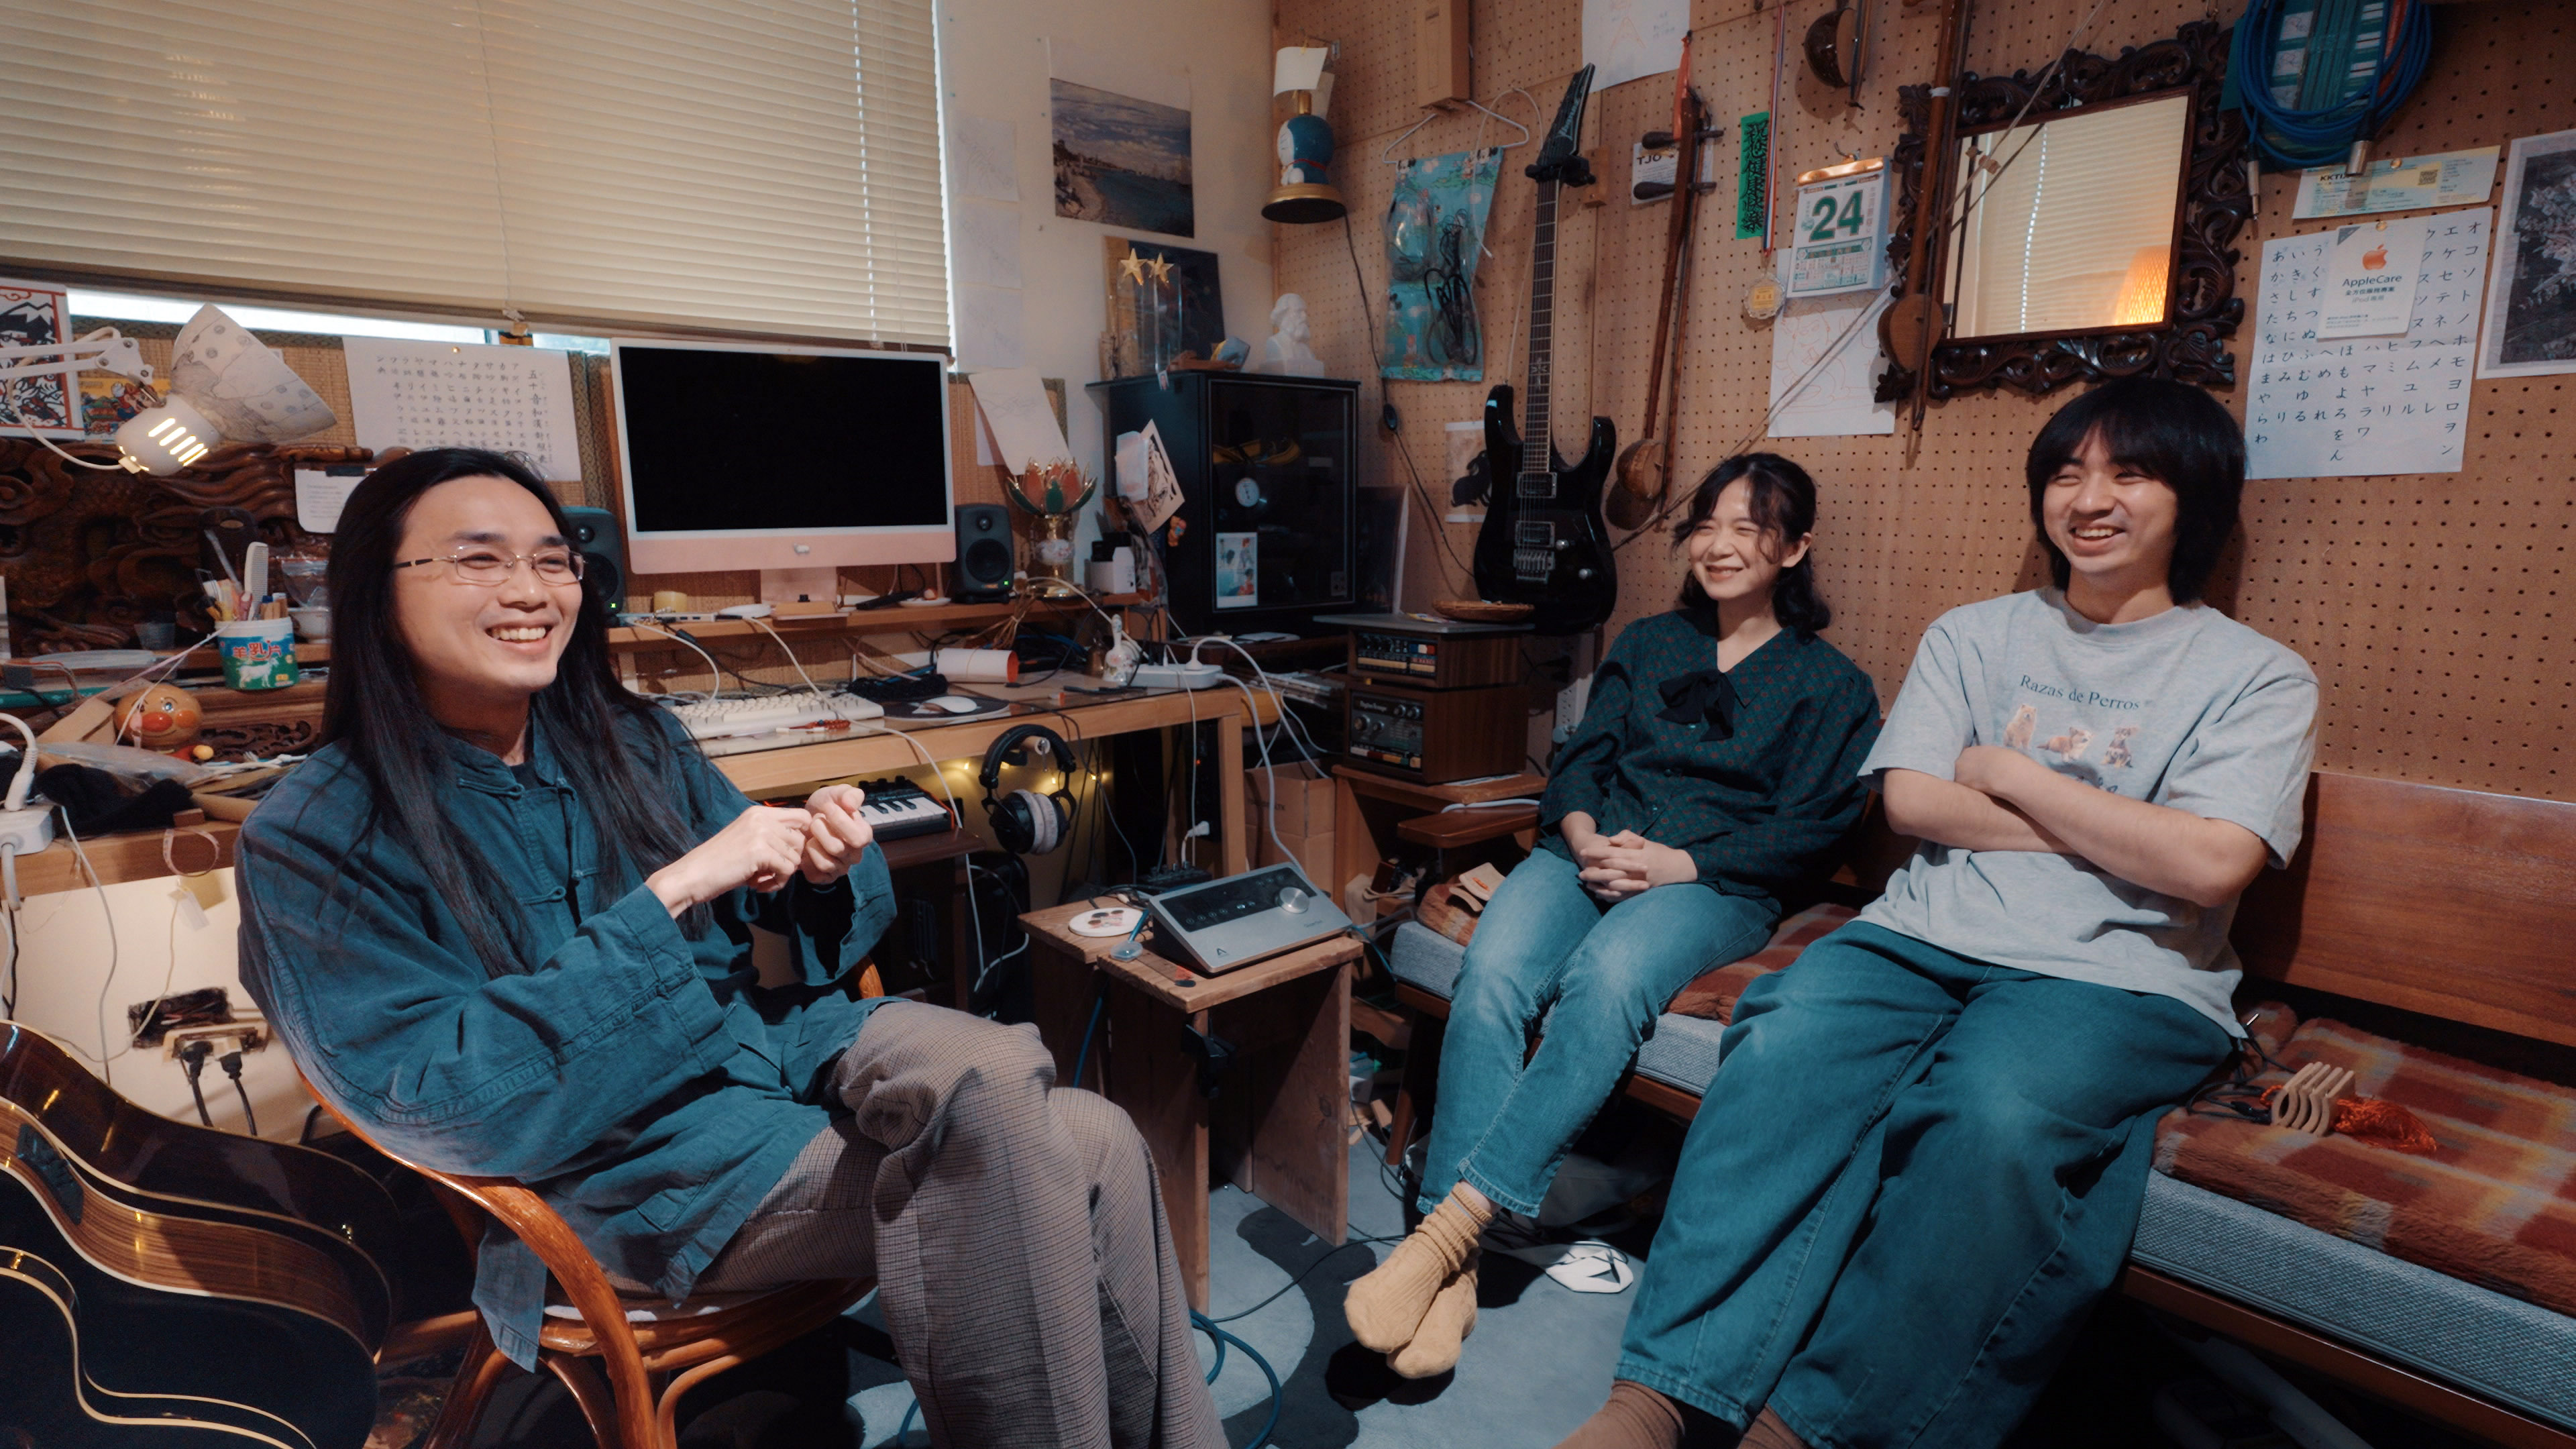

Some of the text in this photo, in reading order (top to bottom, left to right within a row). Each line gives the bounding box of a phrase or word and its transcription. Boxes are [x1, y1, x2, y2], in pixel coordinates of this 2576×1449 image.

[1809, 189, 1864, 242] 24
[2342, 274, 2402, 288] AppleCare
[2020, 674, 2141, 710] Razas de Perros
